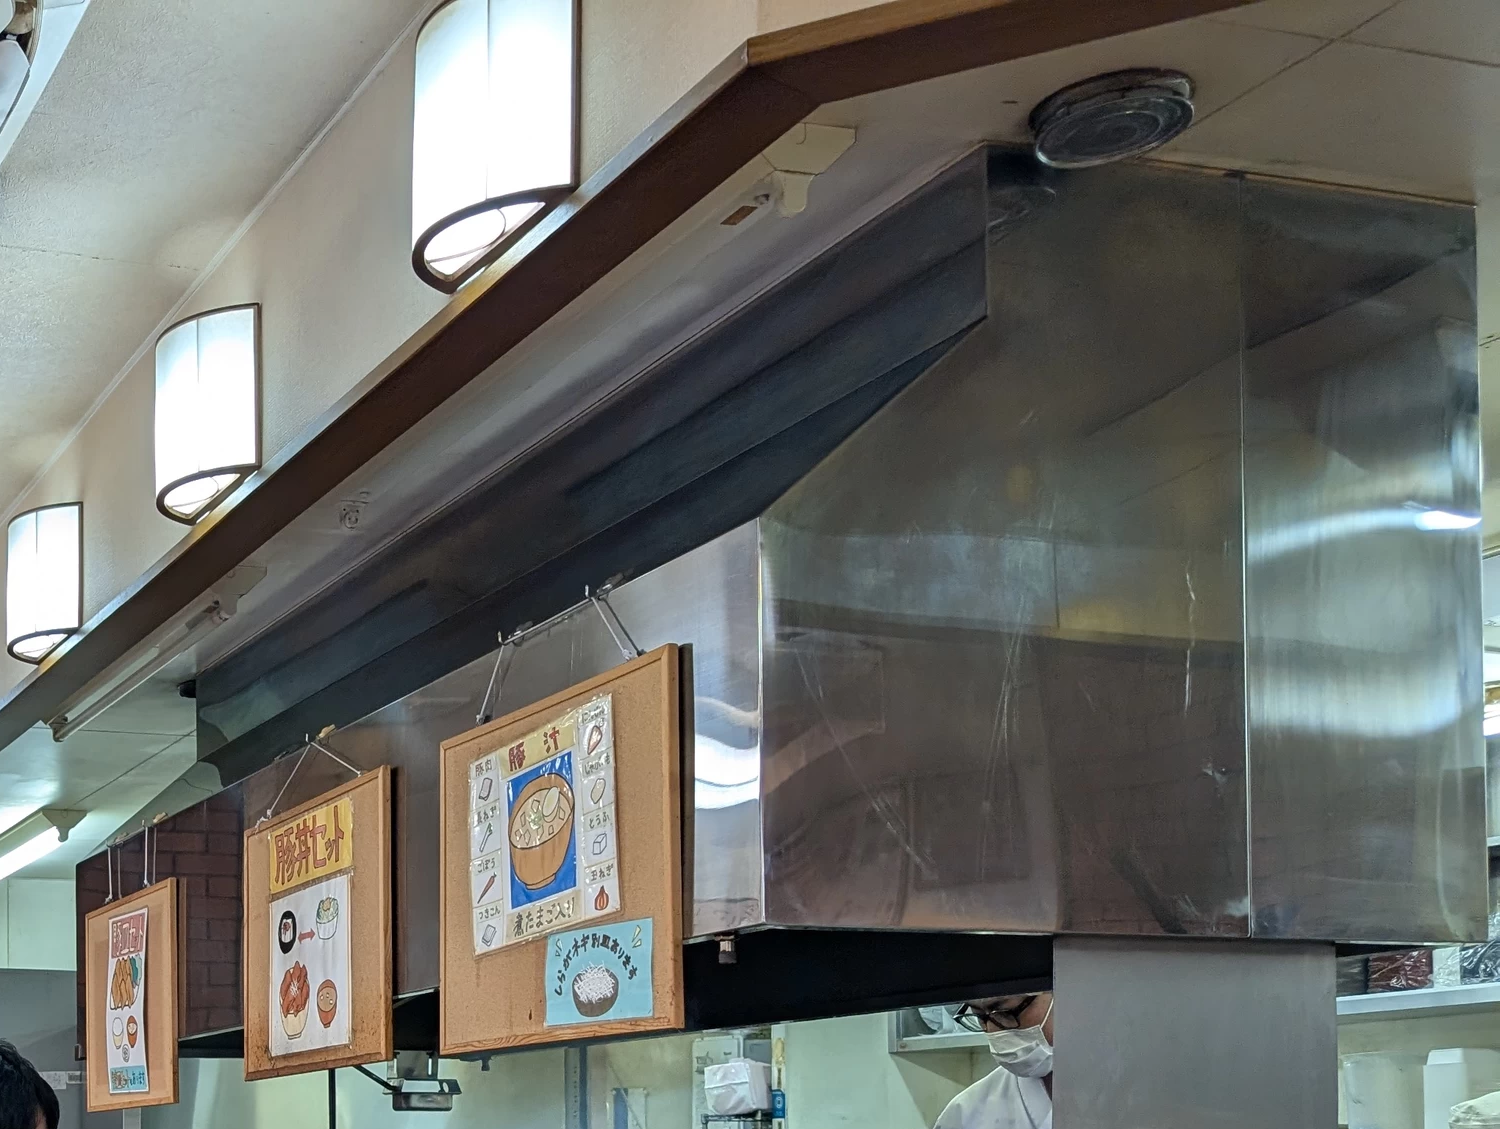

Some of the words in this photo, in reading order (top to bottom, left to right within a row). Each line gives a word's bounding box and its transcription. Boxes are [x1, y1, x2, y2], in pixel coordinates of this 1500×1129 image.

[508, 726, 560, 772] 豚汁
[588, 811, 611, 830] とうふ
[274, 804, 345, 885] 豚丼セット
[477, 858, 496, 874] ごぼう
